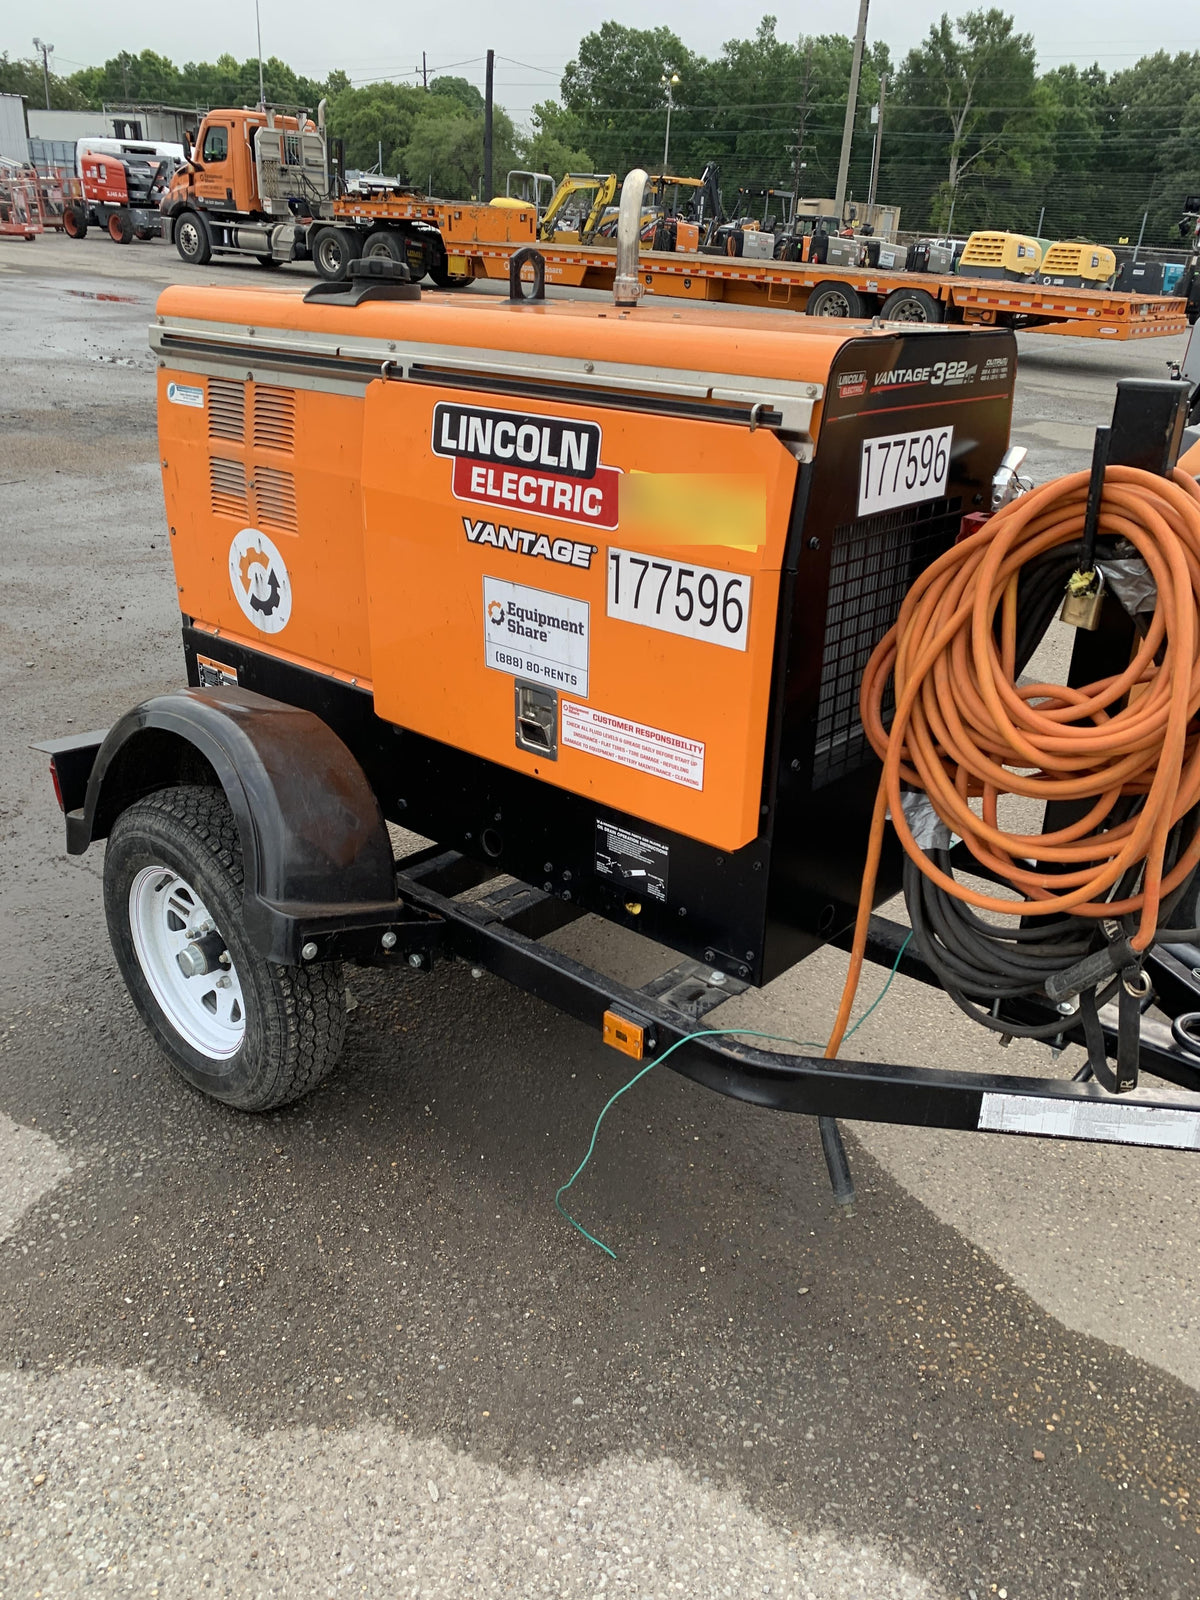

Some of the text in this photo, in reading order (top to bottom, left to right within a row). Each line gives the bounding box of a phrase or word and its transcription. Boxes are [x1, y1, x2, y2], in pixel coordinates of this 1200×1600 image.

[838, 374, 864, 386] LINCOLN
[842, 386, 863, 395] ELECTRIC
[874, 361, 968, 386] VANTAGE 322
[440, 412, 590, 472] LINCOLN
[864, 432, 948, 499] 177596
[470, 466, 604, 517] ELECTRIC
[463, 518, 591, 568] VANTAGE
[610, 553, 744, 634] 177596
[506, 601, 584, 636] Equipment
[507, 619, 548, 642] Share
[496, 651, 577, 686] (888) 80-RENTS
[566, 720, 580, 729] CHECK
[603, 732, 618, 742] LEVELS
[656, 748, 673, 760] BEFORE
[674, 755, 690, 765] START
[593, 713, 703, 754] CUSTOMER RESPONSIBILITY
[601, 740, 611, 748] FLAT
[629, 750, 639, 758] TIRE
[663, 760, 689, 774] REFUELING
[618, 755, 637, 766] BATTERY
